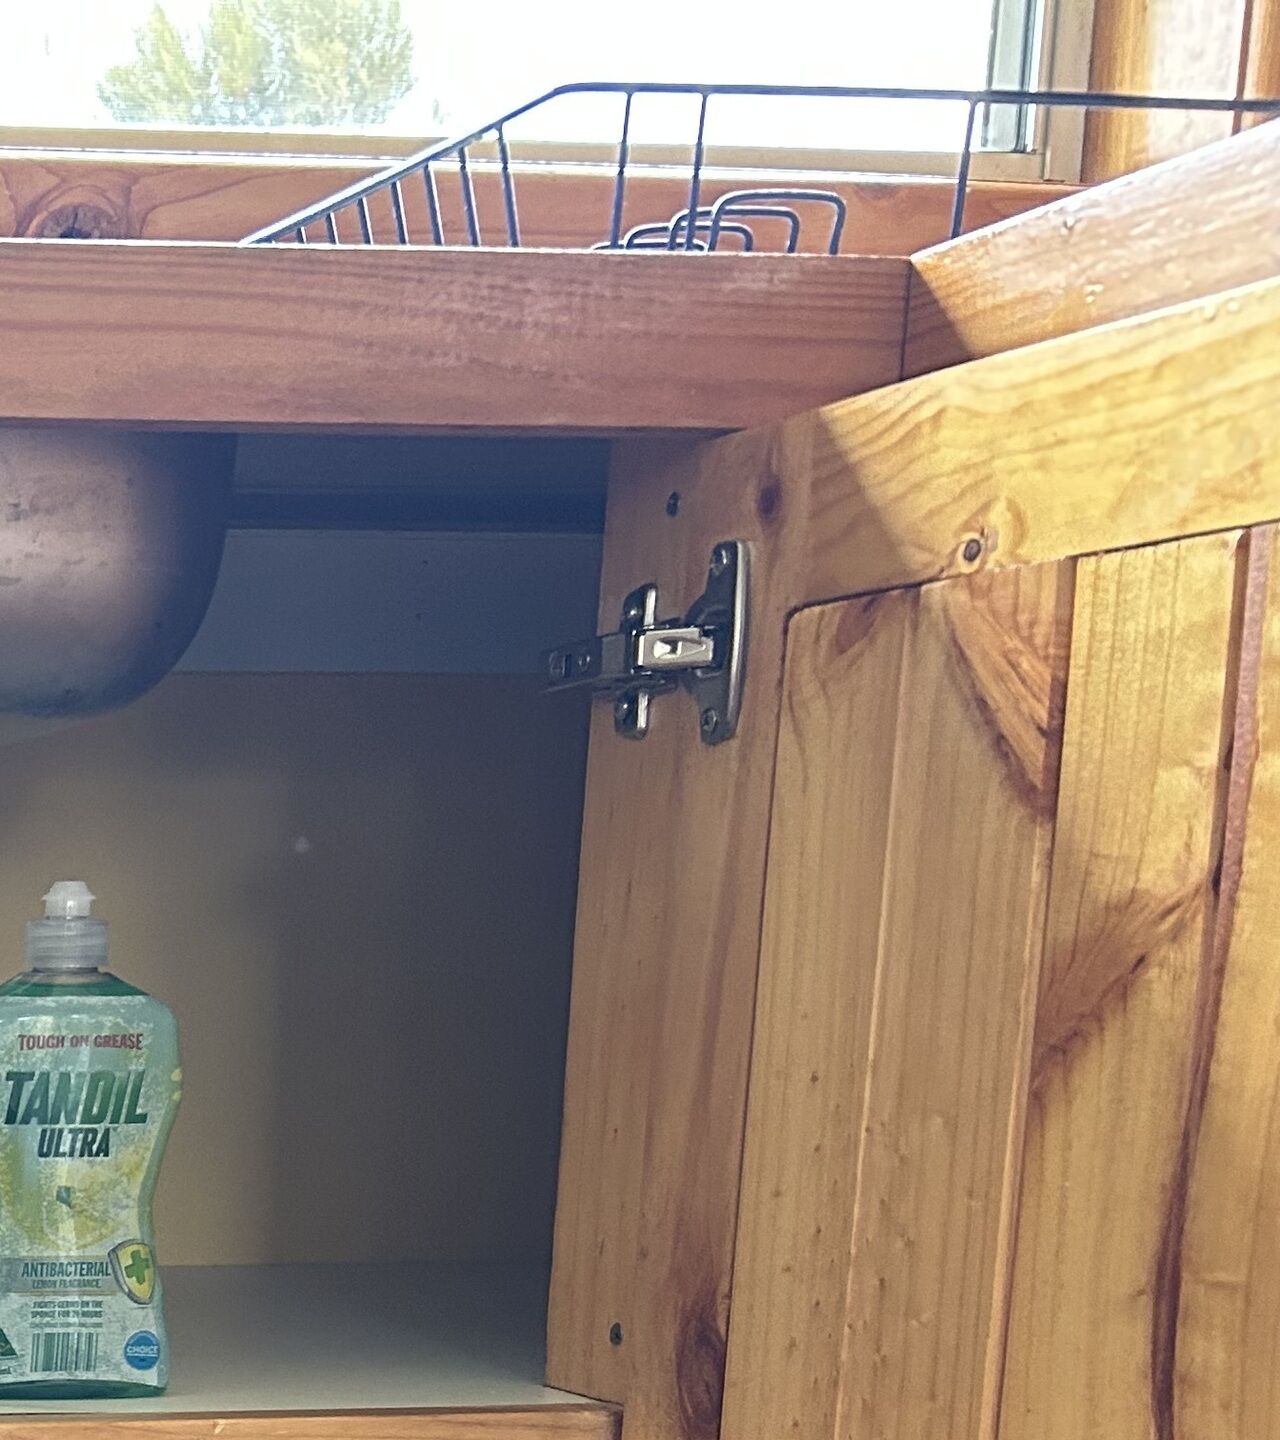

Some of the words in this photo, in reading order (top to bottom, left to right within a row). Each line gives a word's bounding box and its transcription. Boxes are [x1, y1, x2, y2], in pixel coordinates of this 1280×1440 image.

[18, 1034, 66, 1051] TOUGH
[69, 1034, 90, 1048] ON
[93, 1033, 144, 1050] GREASE
[4, 1069, 149, 1125] TANDIL
[37, 1127, 111, 1158] ULTRA
[21, 1261, 112, 1278] ANTIBACTERIAL
[126, 1345, 159, 1355] CHOICE
